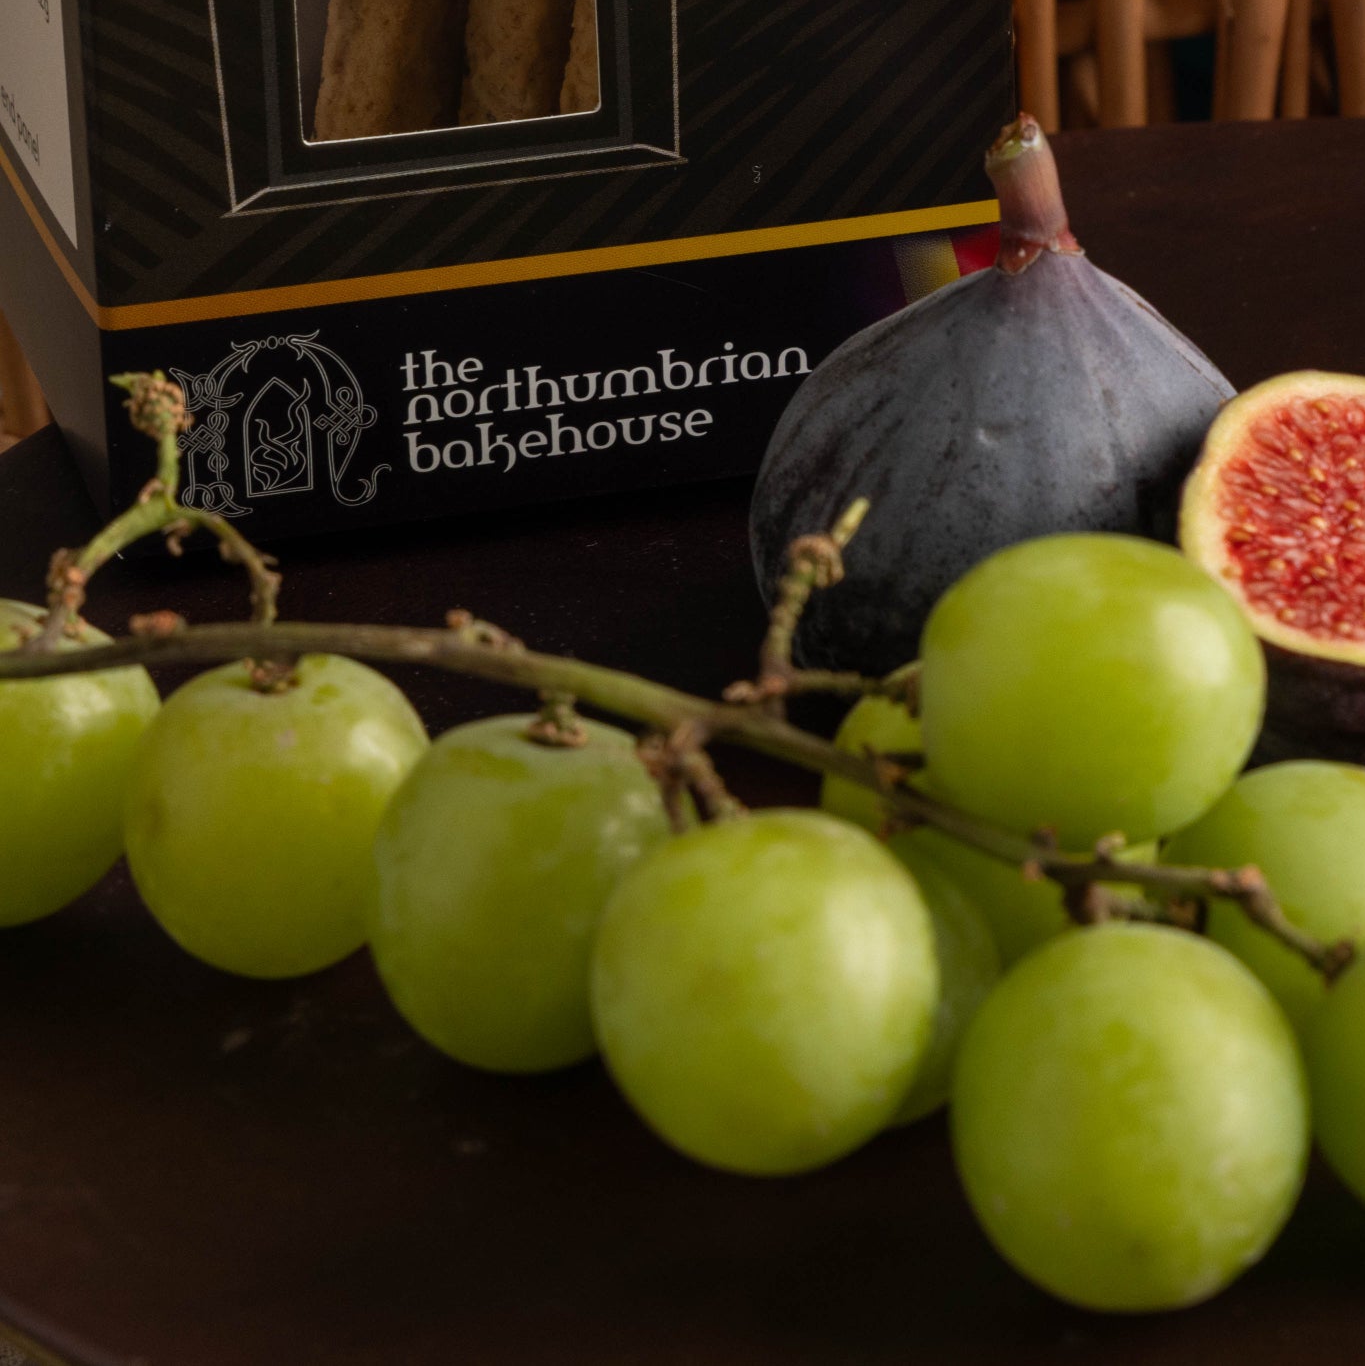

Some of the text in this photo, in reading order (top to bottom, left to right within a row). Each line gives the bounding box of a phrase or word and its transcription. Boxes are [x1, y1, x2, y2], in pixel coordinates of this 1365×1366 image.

[400, 350, 485, 391] the
[402, 341, 812, 425] northumbrian
[403, 408, 715, 475] bakehouse
